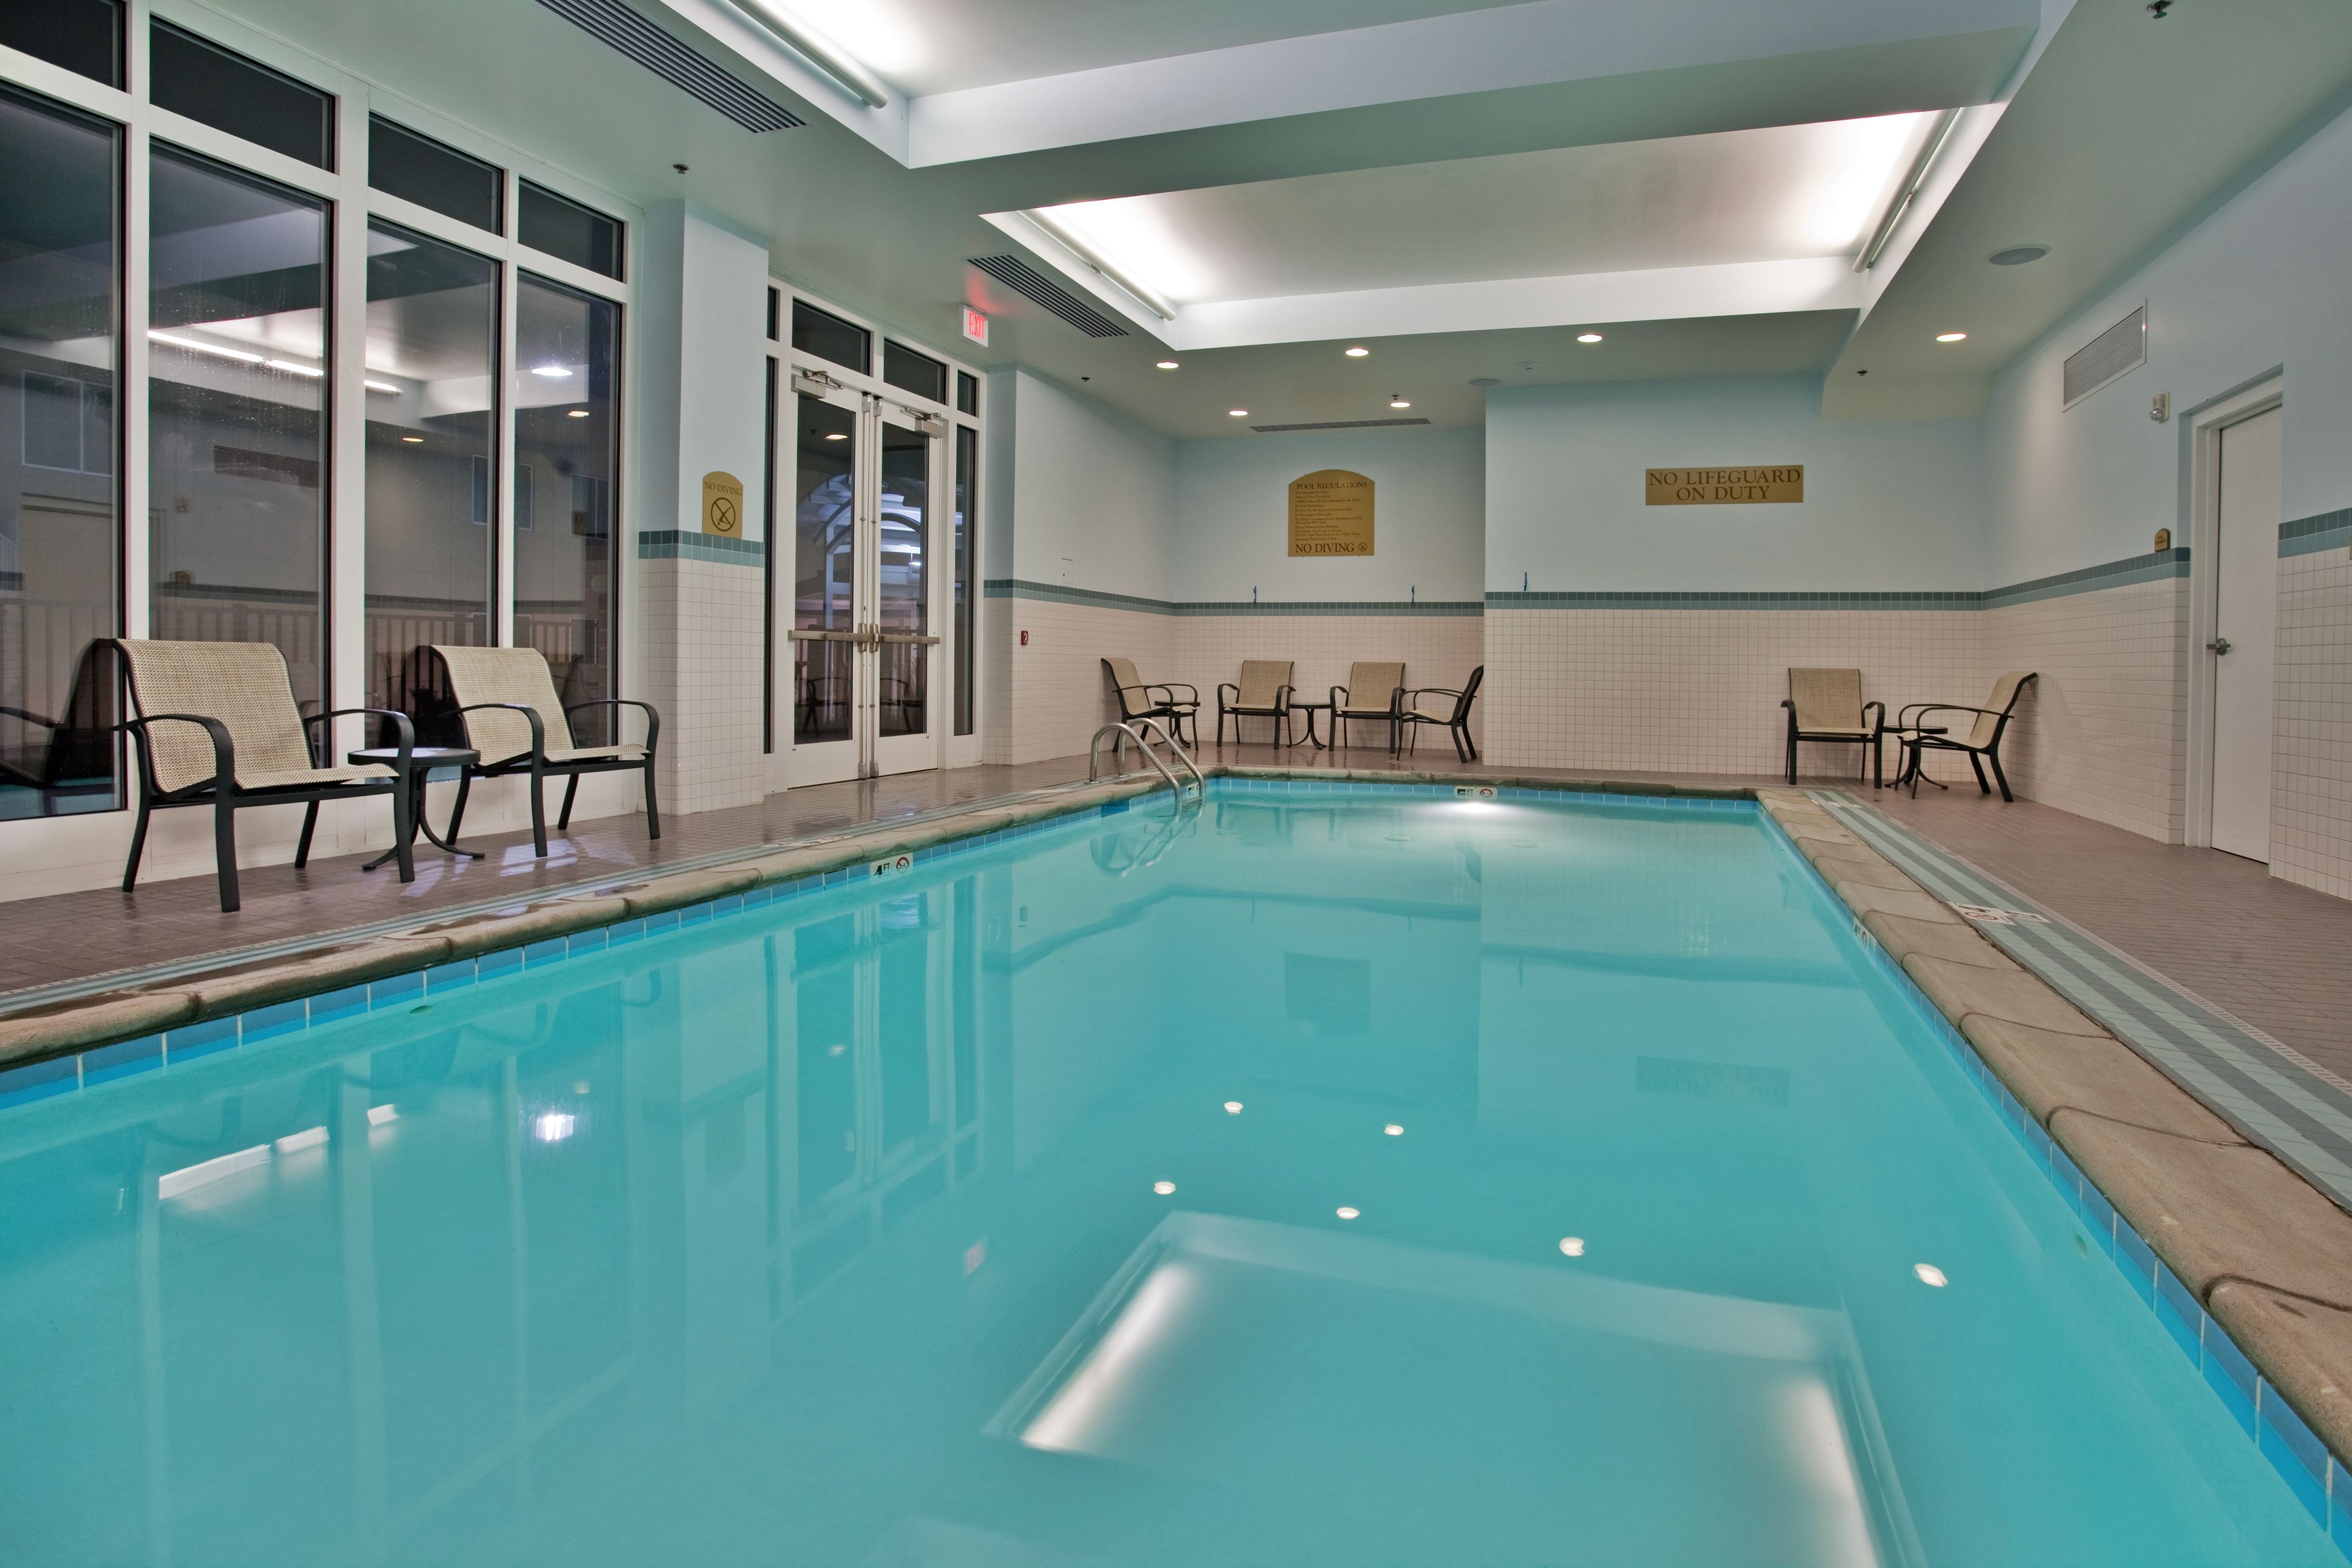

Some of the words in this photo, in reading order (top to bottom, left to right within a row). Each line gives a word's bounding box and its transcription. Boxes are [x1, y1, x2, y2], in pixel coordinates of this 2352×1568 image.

[968, 310, 986, 340] EXIT
[1649, 472, 1678, 486] NO
[1686, 469, 1801, 485] LIFEGUARD
[704, 481, 716, 491] NO
[717, 484, 742, 496] DIVING
[1676, 487, 1706, 500] ON
[1714, 486, 1770, 500] DUTY
[1295, 543, 1312, 553] NO
[1315, 543, 1354, 552] DIVING
